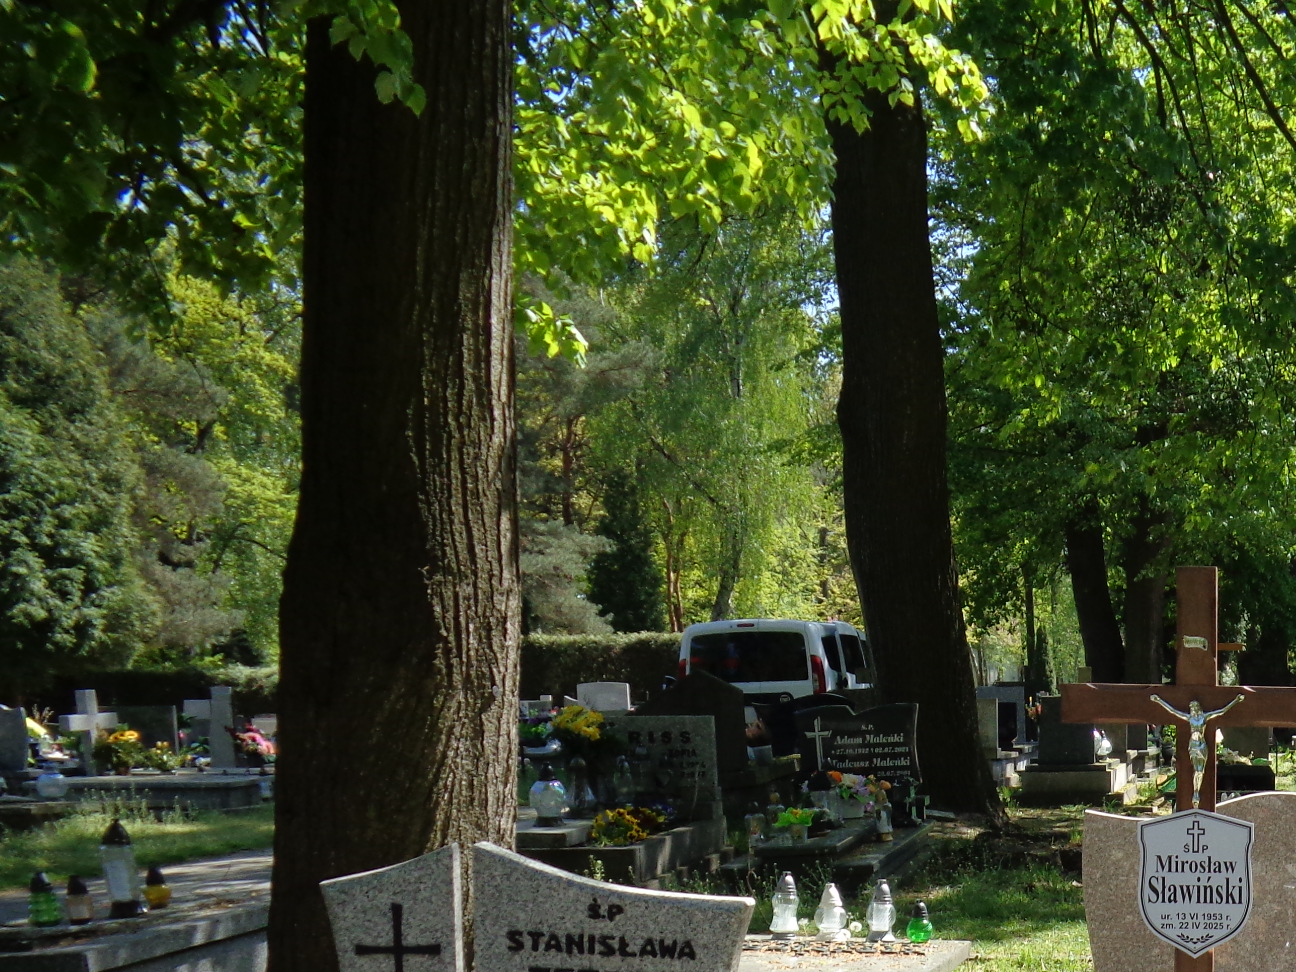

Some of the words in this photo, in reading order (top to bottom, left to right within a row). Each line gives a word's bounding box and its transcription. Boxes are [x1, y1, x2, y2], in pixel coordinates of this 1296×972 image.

[834, 735, 863, 745] Adam
[1155, 855, 1238, 874] Mirosław
[1147, 876, 1243, 905] Sławiński
[506, 929, 696, 961] STANISŁAWA
